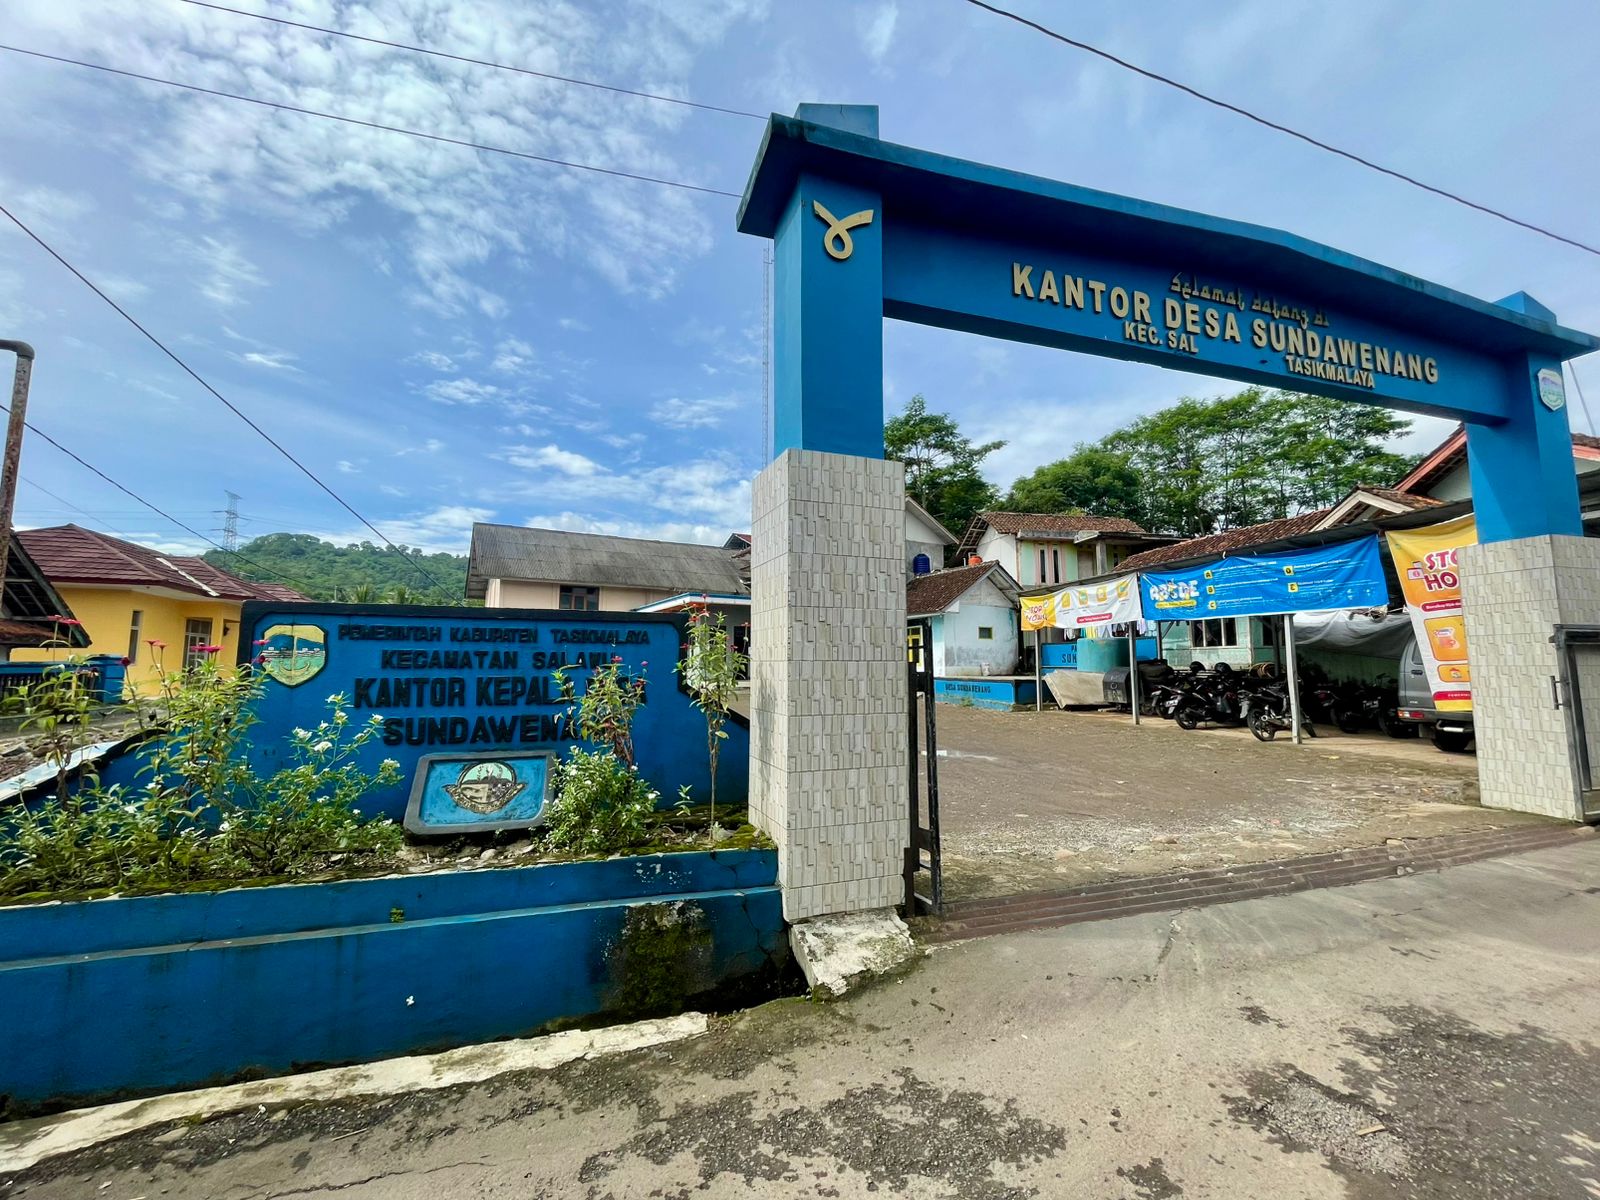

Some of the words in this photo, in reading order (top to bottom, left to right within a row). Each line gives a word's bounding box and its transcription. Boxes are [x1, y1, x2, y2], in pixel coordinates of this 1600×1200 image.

[1013, 262, 1152, 324] KANTOR
[1165, 297, 1242, 343] DESA
[1252, 318, 1439, 384] SUNDAWENANG
[1125, 321, 1164, 345] KEC.
[1168, 330, 1199, 353] SAL
[1285, 355, 1376, 389] TASIKMALAYA
[338, 624, 442, 642] PEMERINTAH
[450, 627, 539, 644] KABUPATEN
[551, 629, 650, 645] TASIKMALAYA
[381, 649, 519, 670] KECAMATAN
[354, 677, 466, 709] KANTOR
[383, 714, 581, 746] SUNDAWENA
